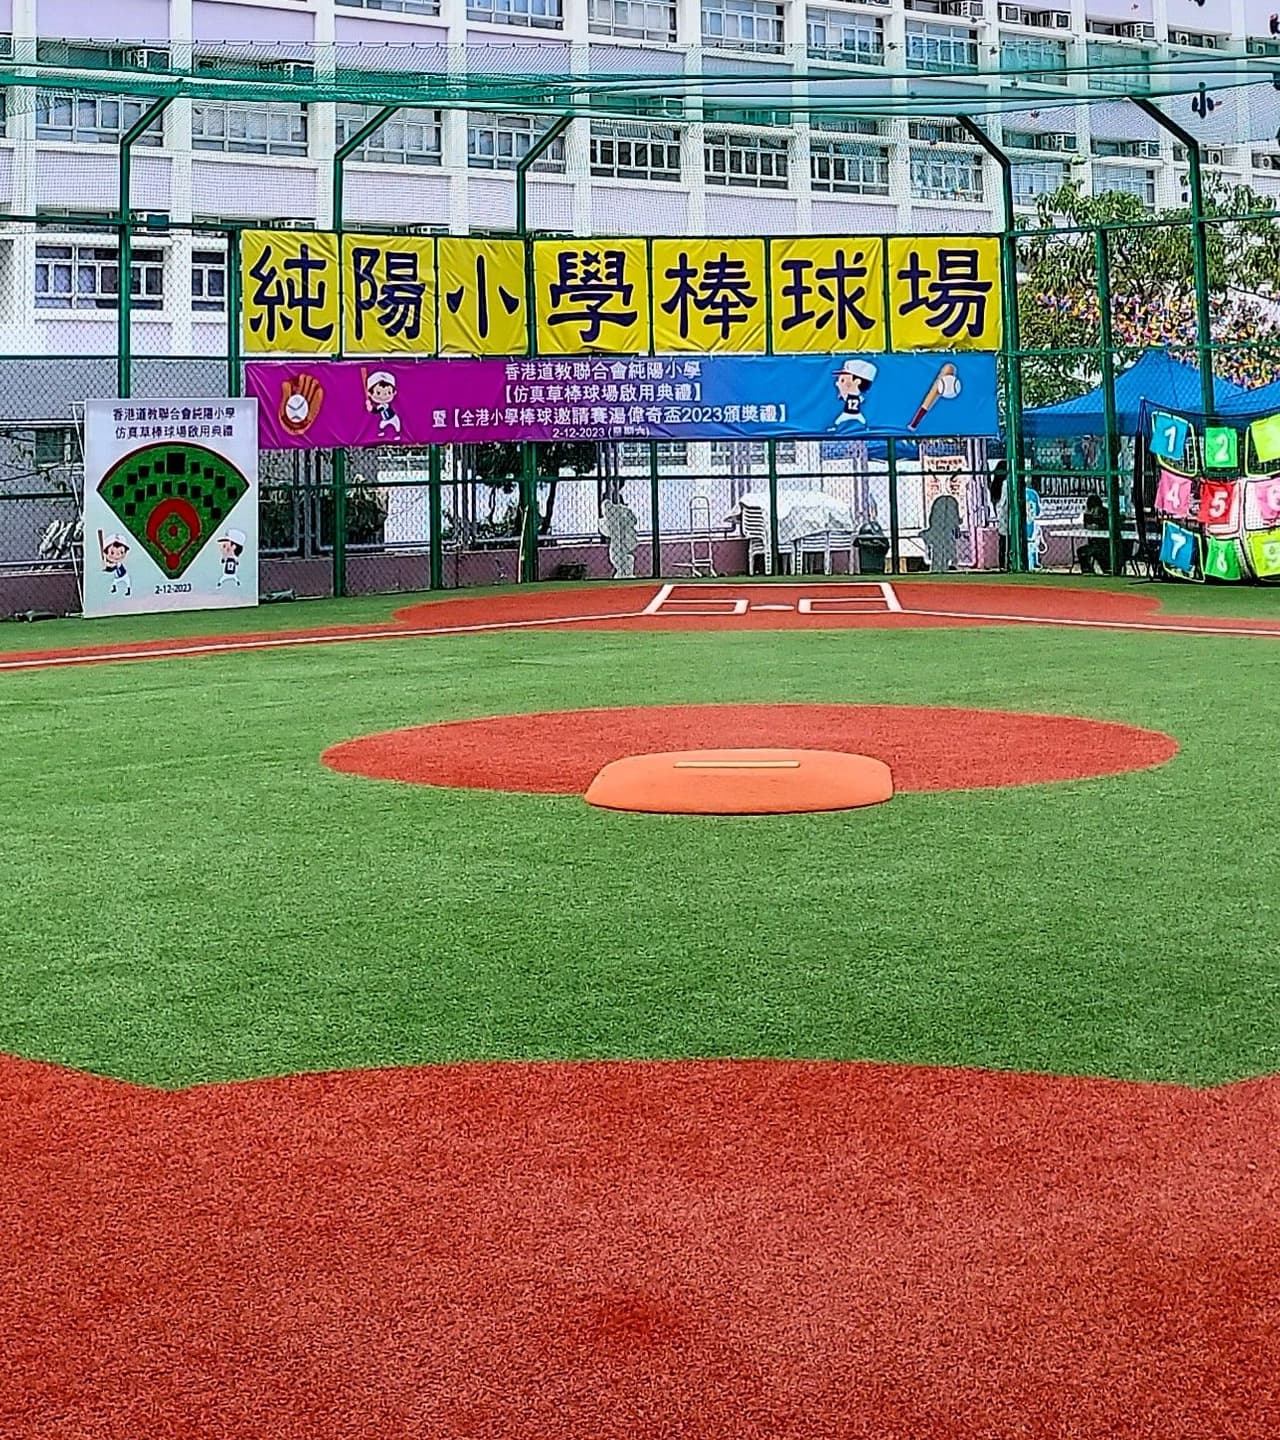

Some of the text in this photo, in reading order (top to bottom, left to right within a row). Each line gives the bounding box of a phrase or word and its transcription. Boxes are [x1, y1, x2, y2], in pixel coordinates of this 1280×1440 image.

[249, 245, 993, 343] 純陽小學棒球場
[505, 362, 701, 380] 香港道教聯合會純陽小學
[552, 427, 605, 439] 2-12-2023
[1164, 425, 1177, 453] 1
[1214, 433, 1230, 464] 2
[1167, 482, 1182, 509] 4
[1209, 490, 1228, 518] 5
[1170, 532, 1186, 561] 7
[154, 583, 192, 595] 2-12-2023
